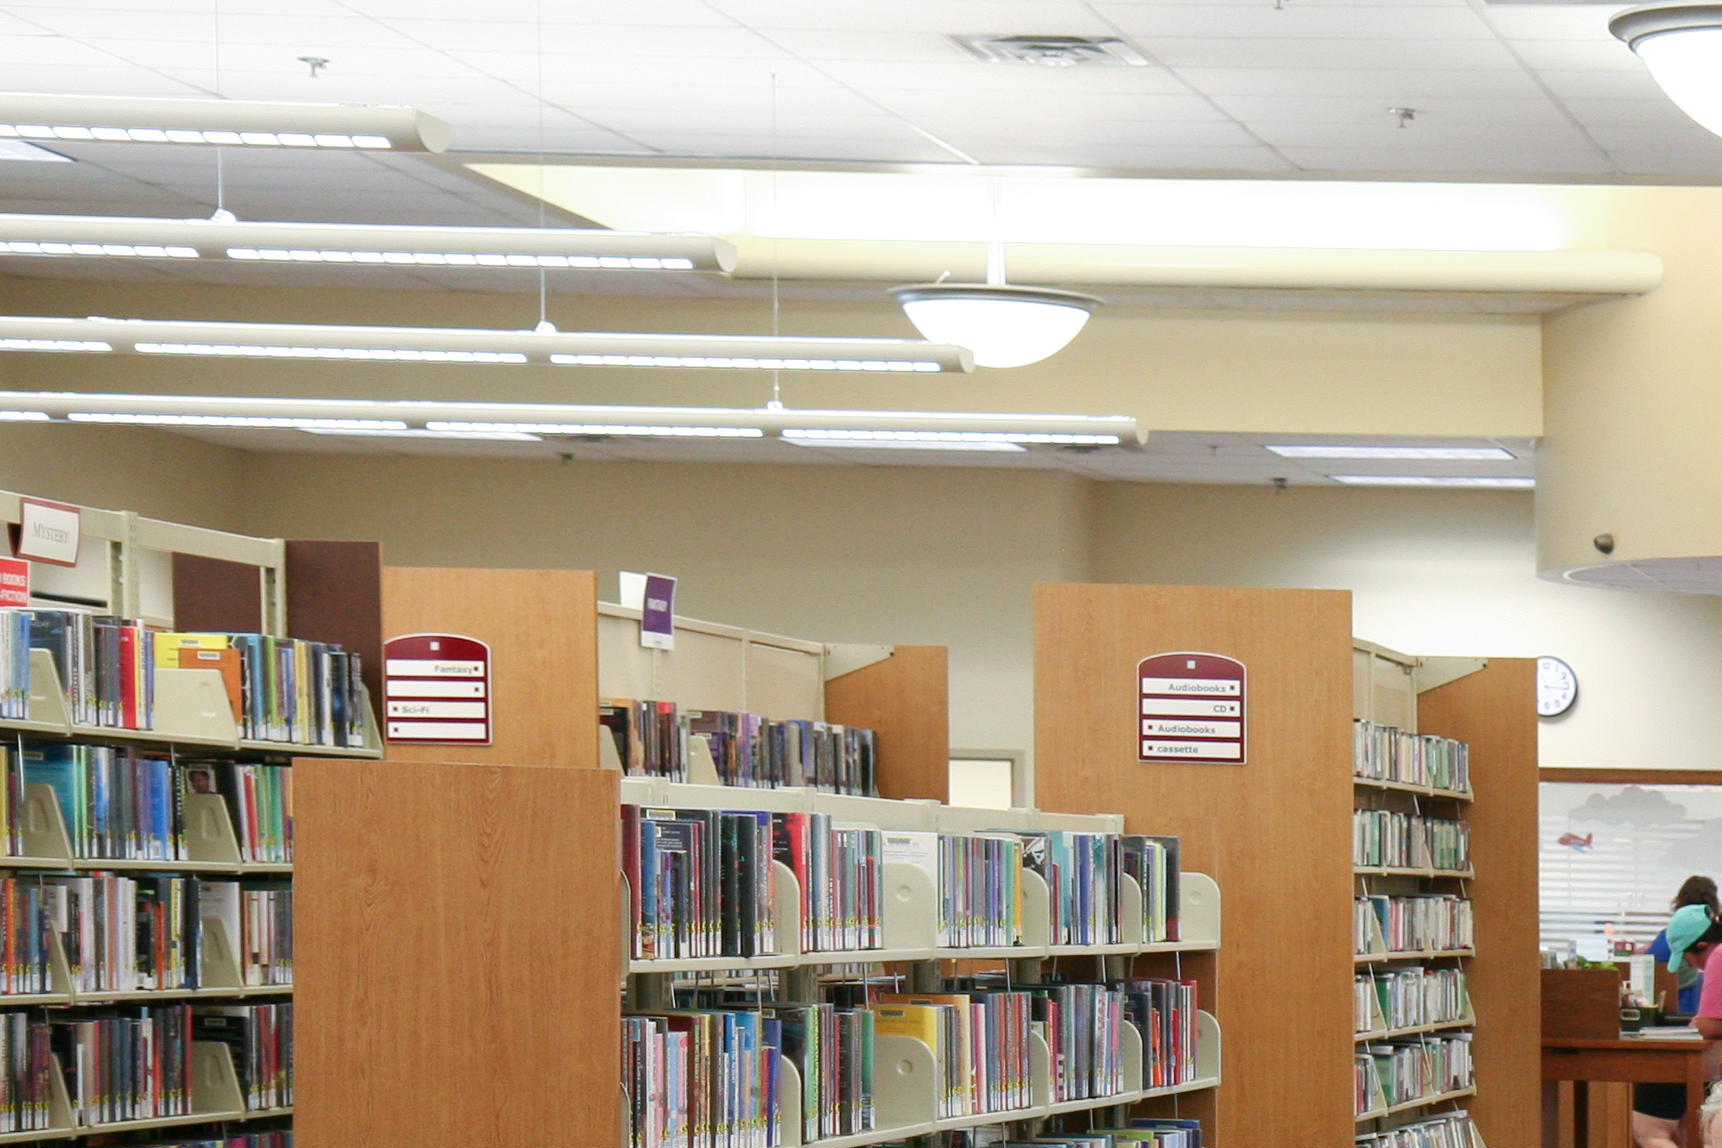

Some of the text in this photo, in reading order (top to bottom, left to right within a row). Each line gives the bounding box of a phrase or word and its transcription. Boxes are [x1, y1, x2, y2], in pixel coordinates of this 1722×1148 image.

[33, 522, 69, 543] MYSTERY
[434, 665, 473, 675] Fantasy
[1168, 683, 1227, 693] Audiobooks
[401, 705, 430, 714] Sci-Fi
[1213, 705, 1227, 713] CD
[1157, 724, 1216, 734] Audiobooks
[1157, 745, 1199, 754] cassette
